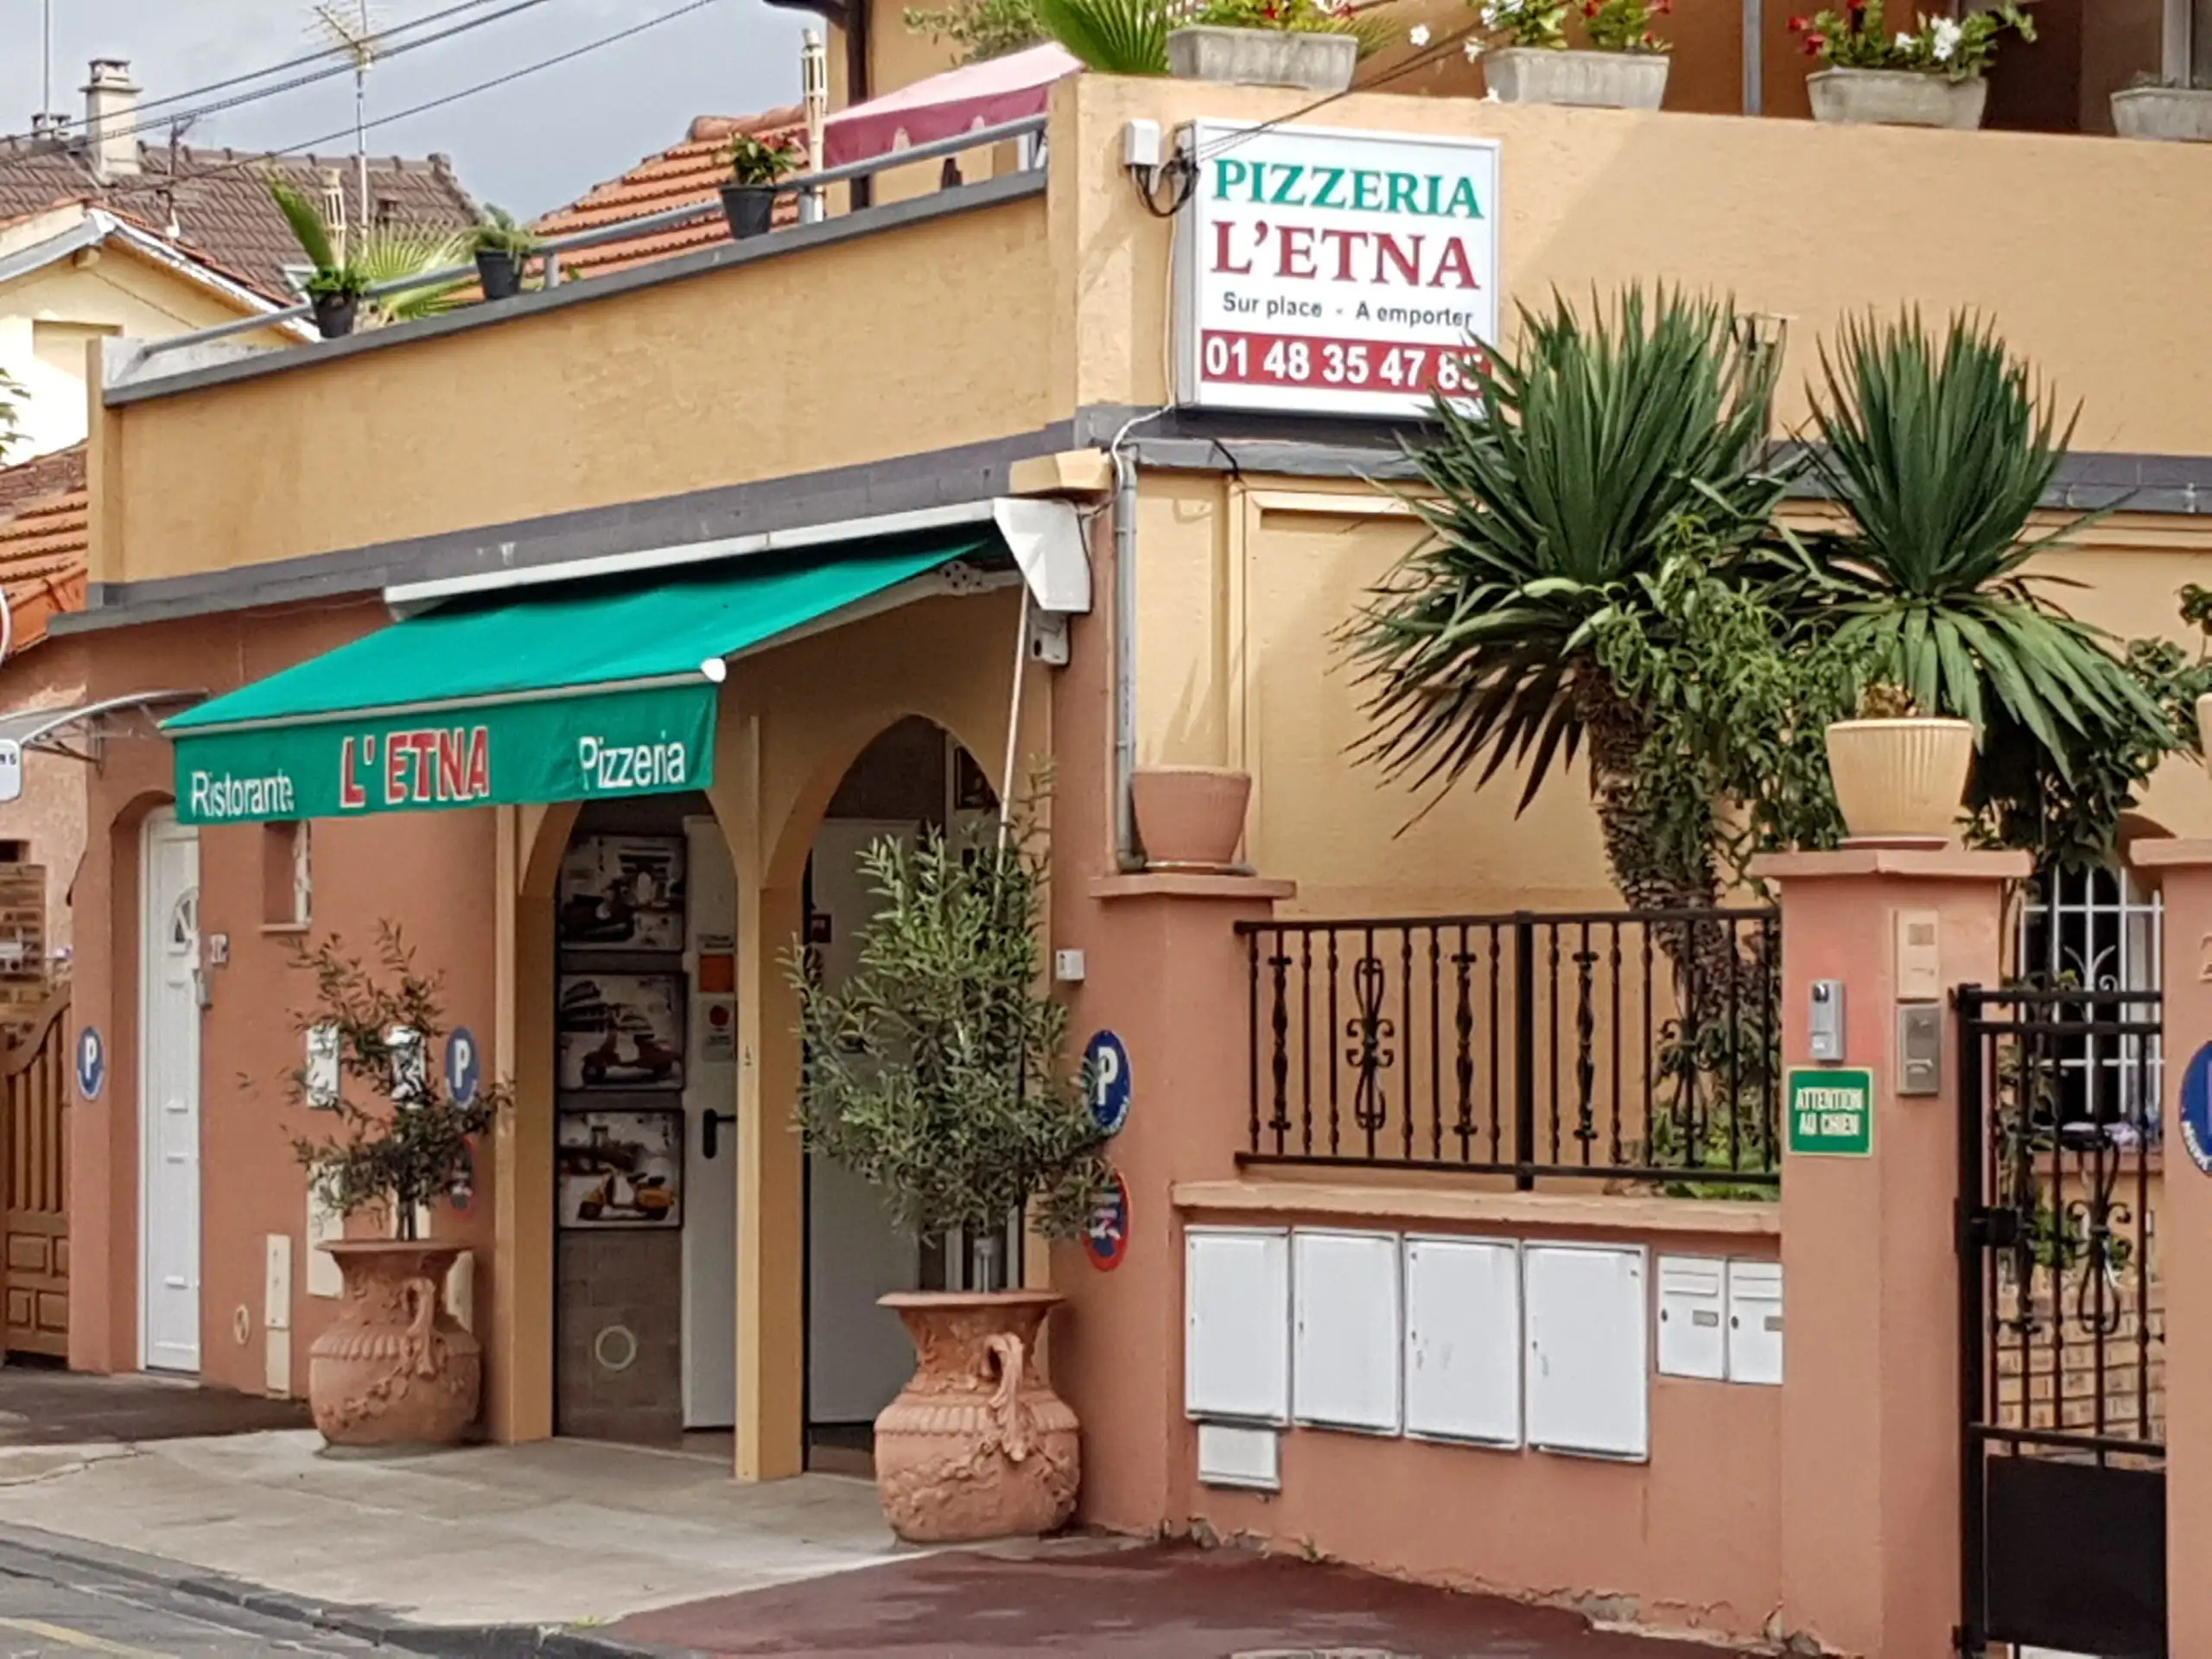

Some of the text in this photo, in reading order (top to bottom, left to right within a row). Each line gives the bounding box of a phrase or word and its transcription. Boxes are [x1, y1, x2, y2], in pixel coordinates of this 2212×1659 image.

[1211, 158, 1485, 219] PIZZERIA
[1211, 220, 1481, 290] L'ETNA
[1223, 290, 1259, 313] Sur
[1267, 295, 1322, 320] place
[1356, 301, 1370, 321] A
[1377, 306, 1473, 328] emporter
[1206, 335, 1248, 378] 01
[1263, 340, 1310, 381] 48
[1322, 344, 1370, 384] 35
[1379, 347, 1426, 387] 47
[579, 729, 685, 791] Pizzeria
[191, 768, 295, 817] Ristorante
[85, 1036, 98, 1080] P
[454, 1039, 471, 1088] P
[1097, 1046, 1118, 1106] P
